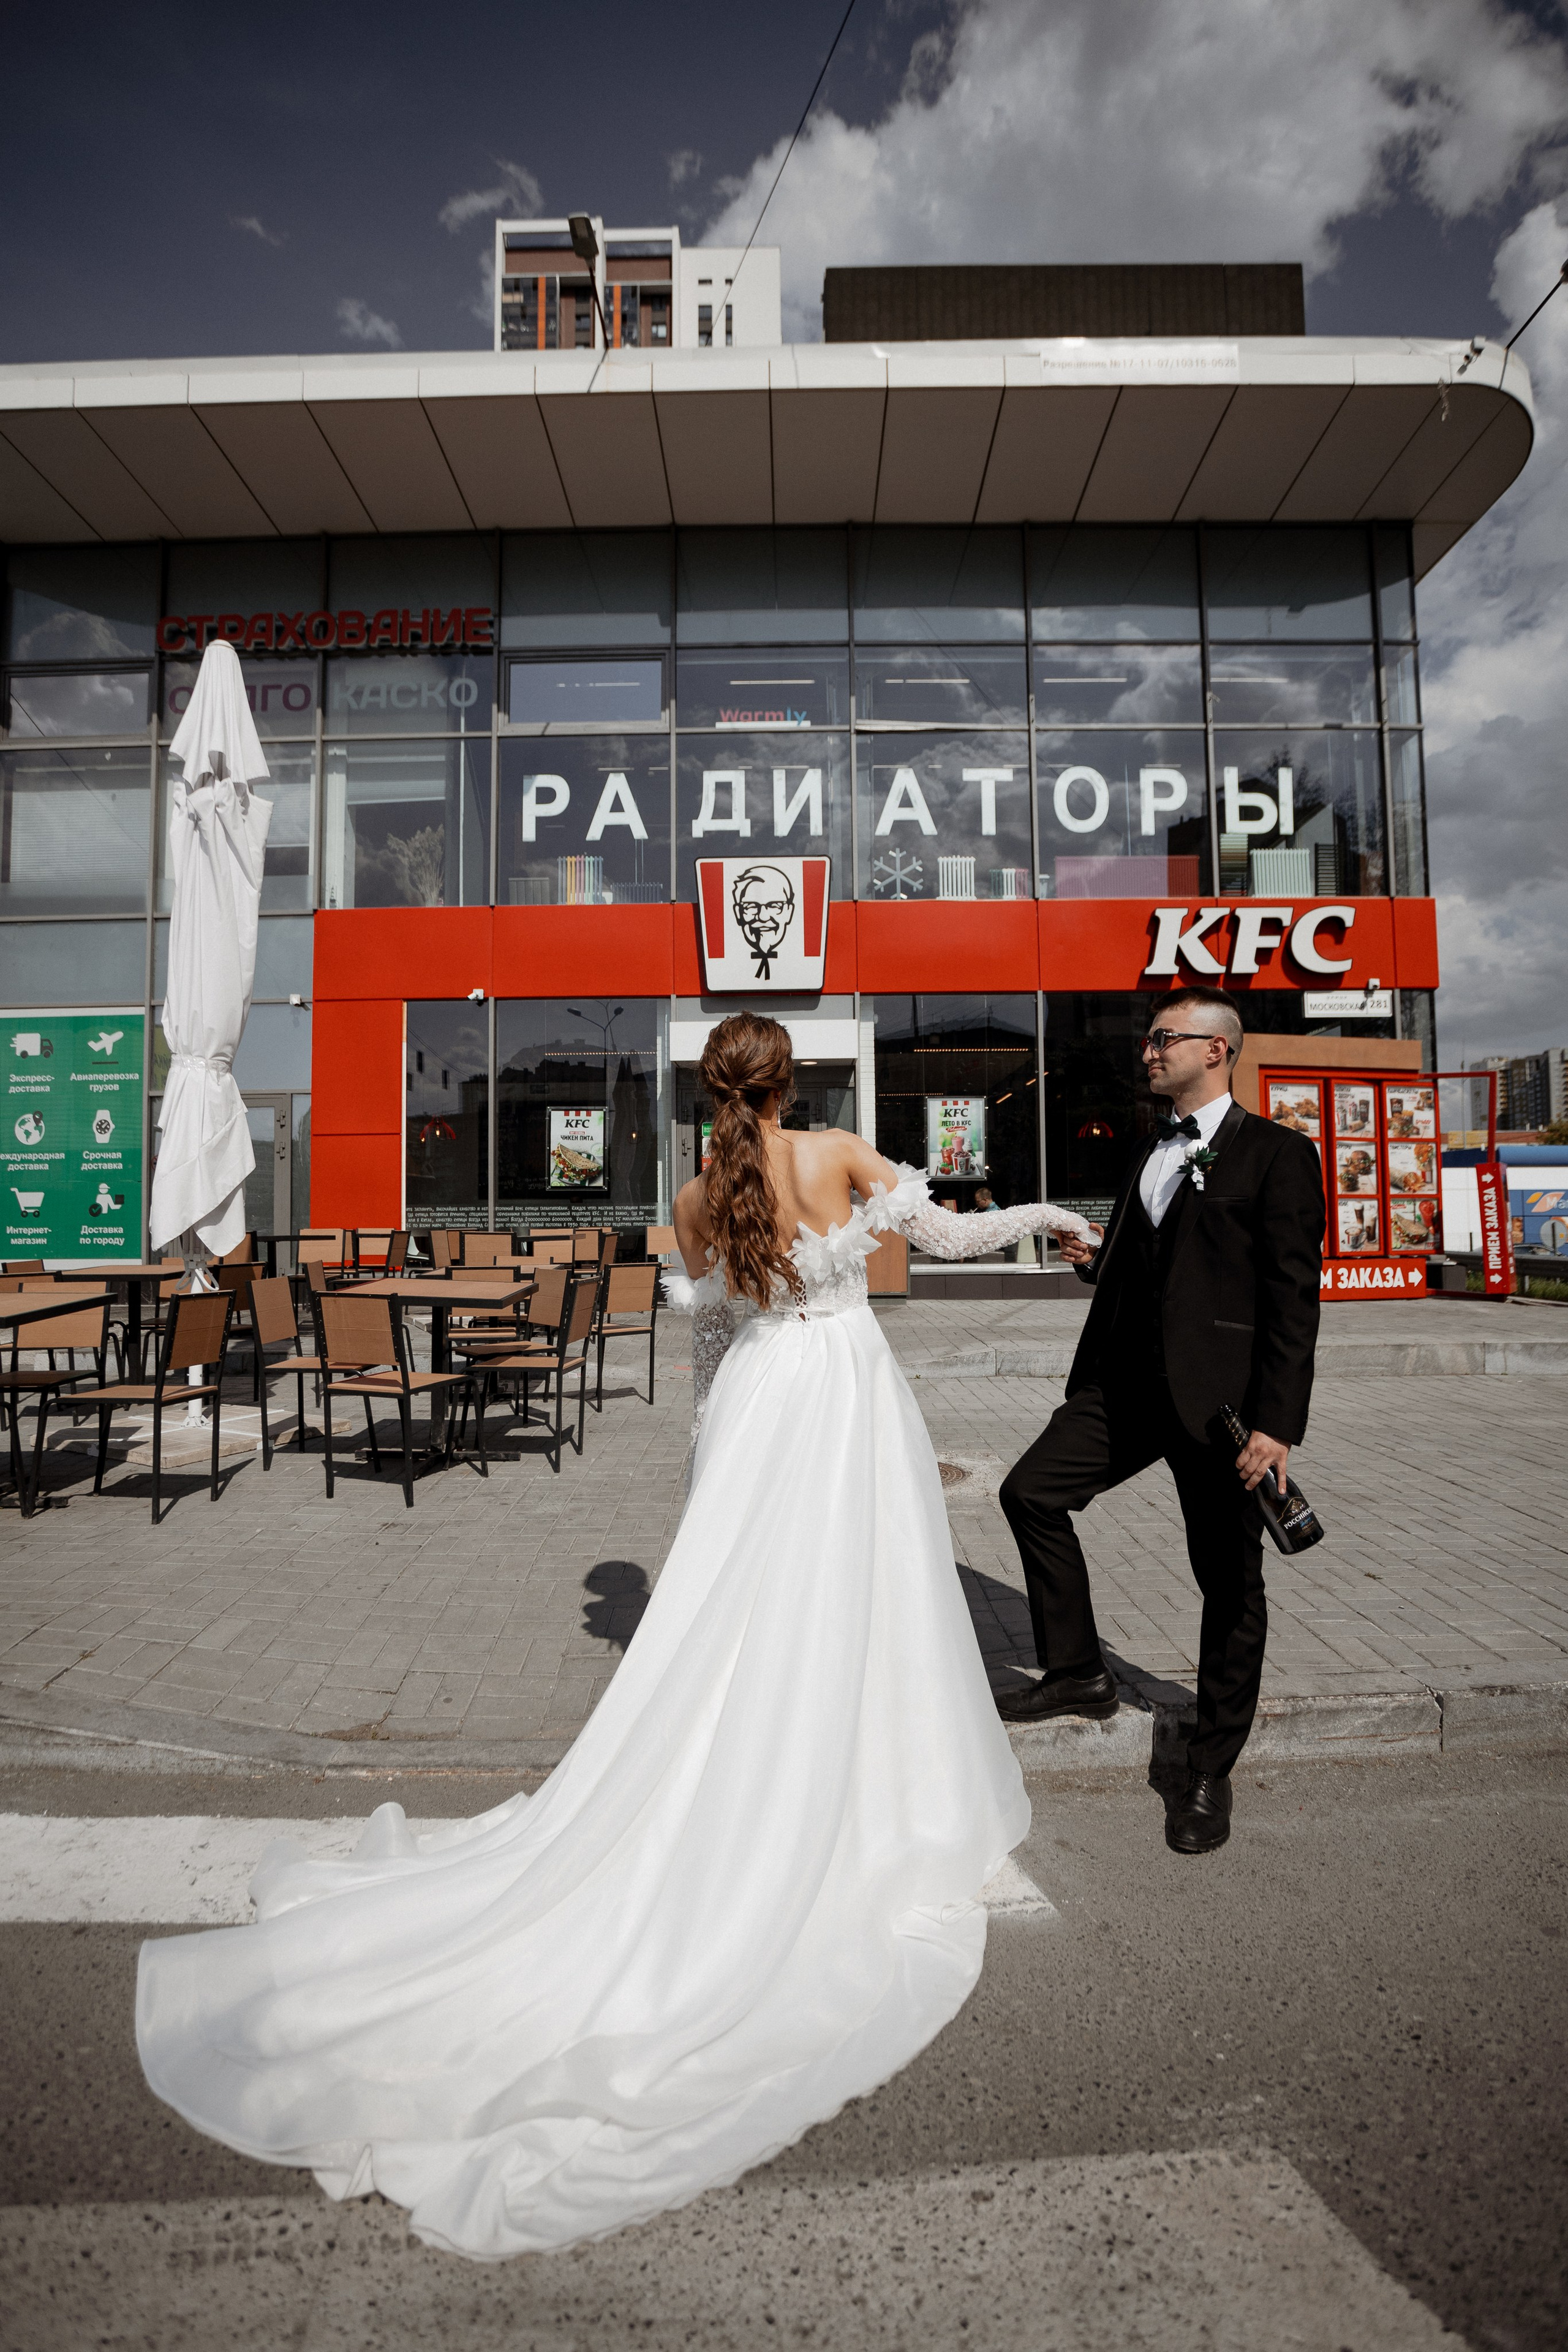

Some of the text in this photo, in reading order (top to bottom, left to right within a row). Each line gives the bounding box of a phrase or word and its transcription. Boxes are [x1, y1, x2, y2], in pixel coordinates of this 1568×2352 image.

[156, 607, 492, 651] СТРАХОВАНИЕ
[169, 677, 479, 714] ОГО КАСКО
[719, 706, 807, 726] Warmly
[522, 766, 1294, 842] РАДИАТОРЫ
[1144, 905, 1356, 975] KFC
[1370, 1000, 1387, 1009] 281
[9, 1074, 55, 1084] Экспресс-
[70, 1072, 139, 1082] Авиаперевозка
[9, 1085, 50, 1094] доставка
[89, 1084, 119, 1093] грузов
[943, 1108, 968, 1117] KFC
[565, 1119, 590, 1128] KFC
[0, 1152, 65, 1161] еждународная
[83, 1150, 122, 1161] Срочная
[81, 1163, 123, 1171] доставка
[6, 1226, 52, 1235] Интернет-
[80, 1225, 124, 1235] Доставка
[1483, 1186, 1502, 1270] ПРИЕМ ЗАКАЗА
[93, 1237, 125, 1246] городу
[1337, 1267, 1405, 1289] ЗАКАЗА
